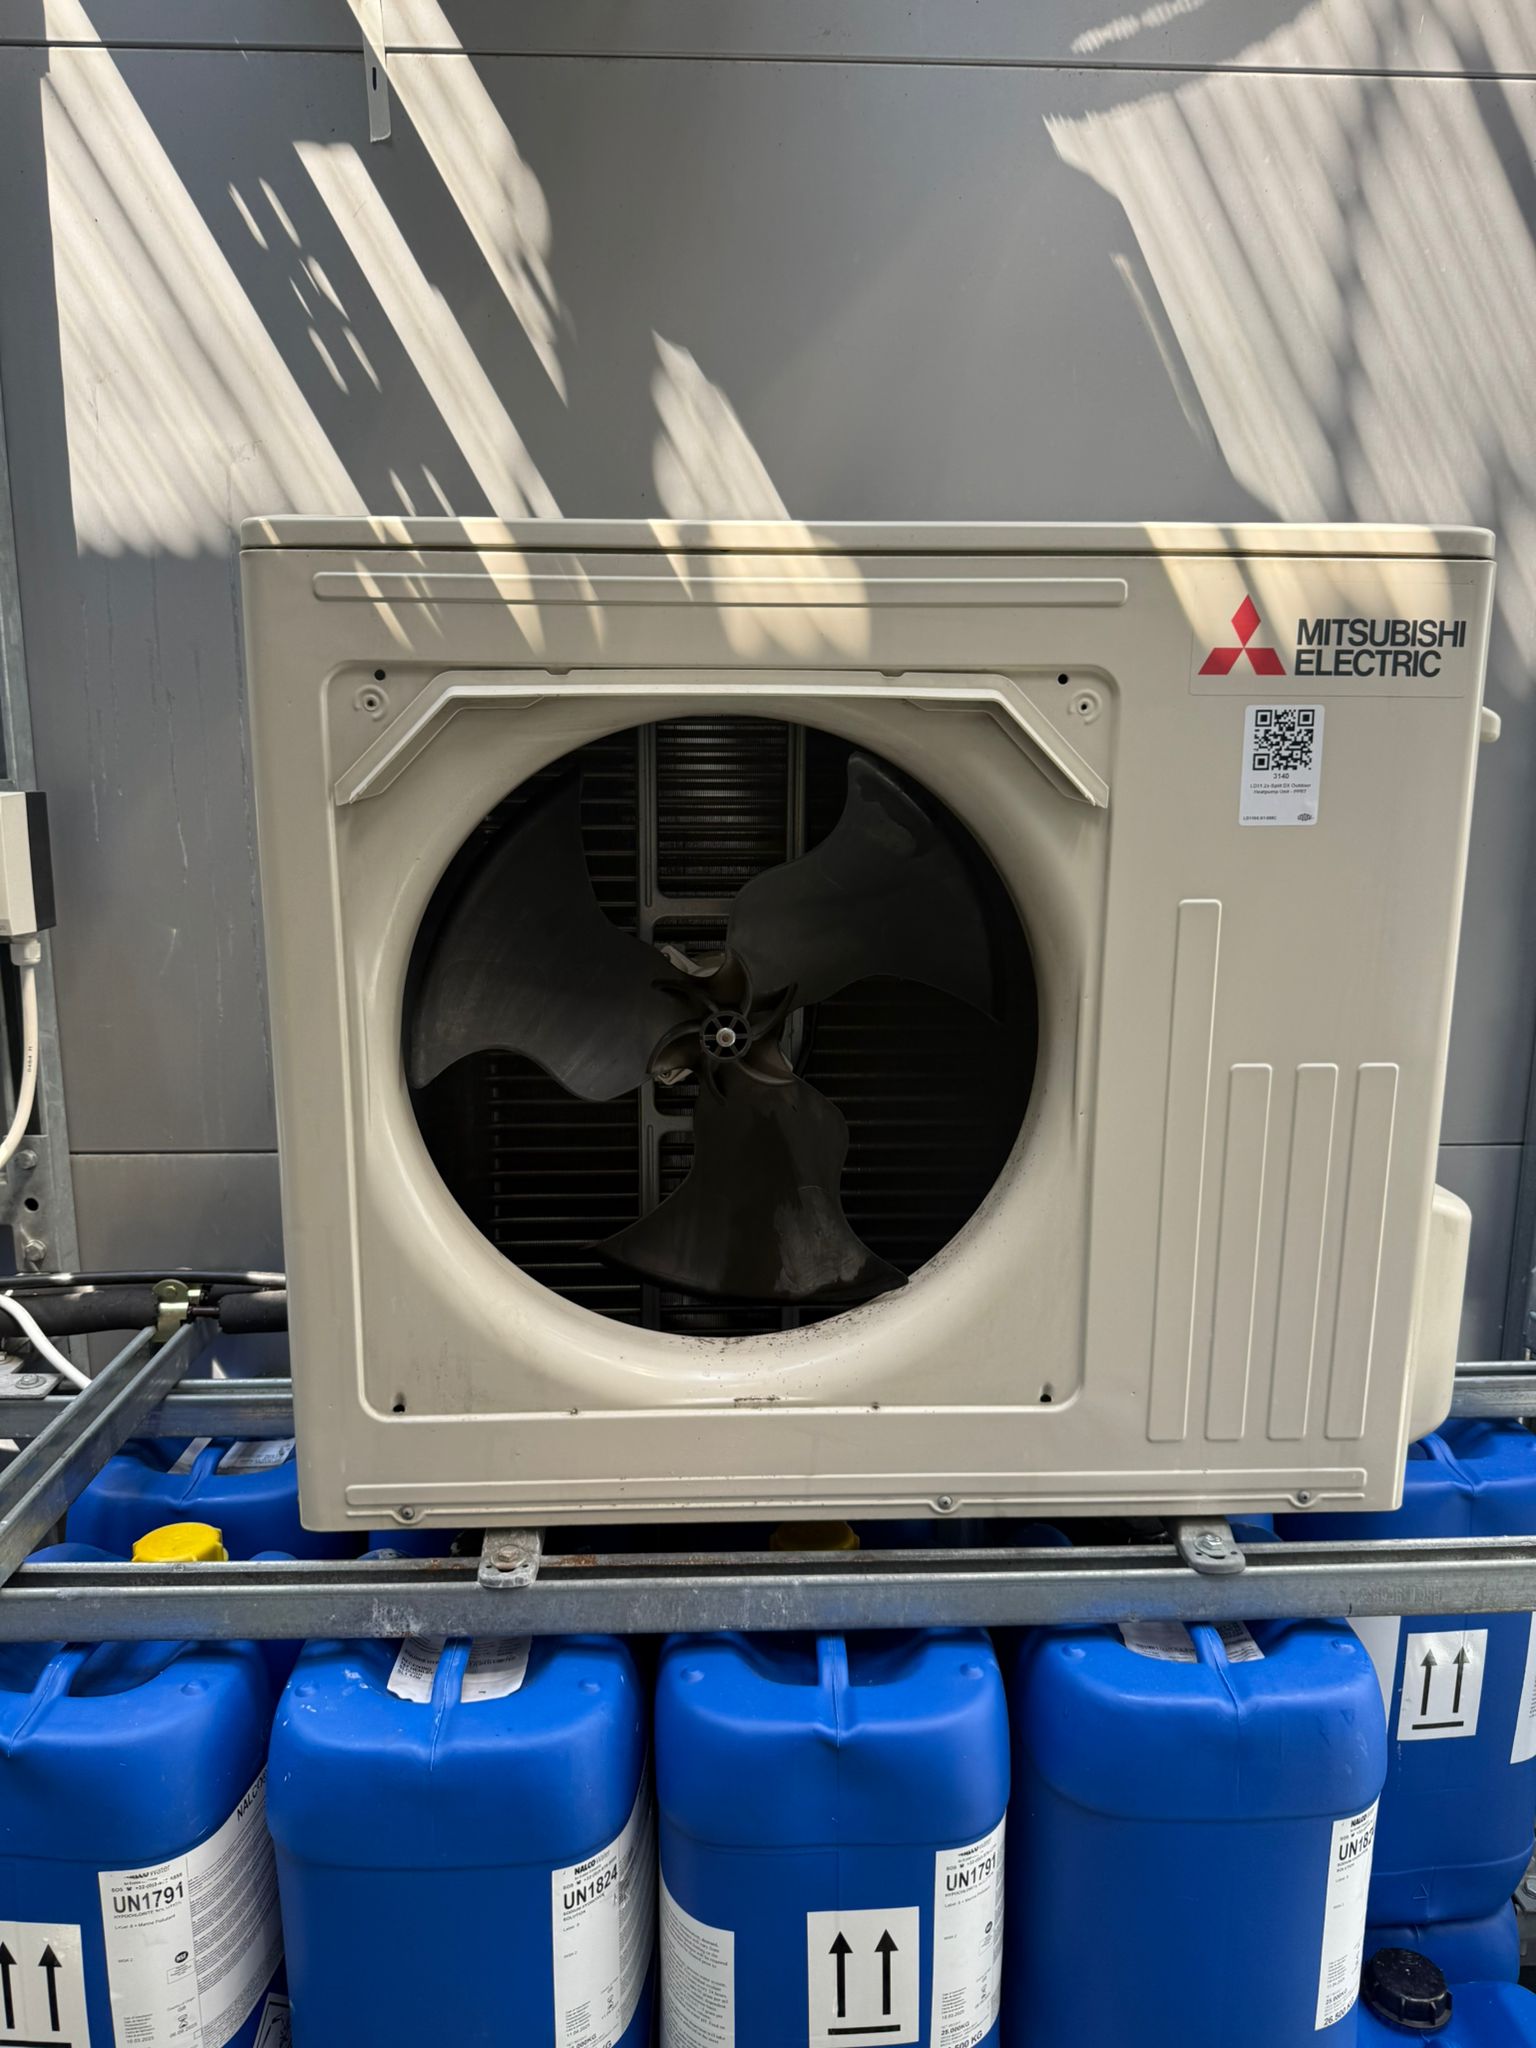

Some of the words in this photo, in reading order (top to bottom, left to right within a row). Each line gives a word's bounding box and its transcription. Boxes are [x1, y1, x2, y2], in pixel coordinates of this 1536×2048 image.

[1296, 618, 1467, 648] MITSUBISHI
[1294, 649, 1442, 678] ELECTRIC
[1272, 772, 1290, 780] 3140
[1338, 1827, 1374, 1861] UN182
[574, 1859, 596, 1876] NALCO
[946, 1851, 996, 1892] UN1791
[113, 1881, 184, 1914] UN1791
[563, 1863, 618, 1910] UN1824
[970, 2029, 984, 2045] KG
